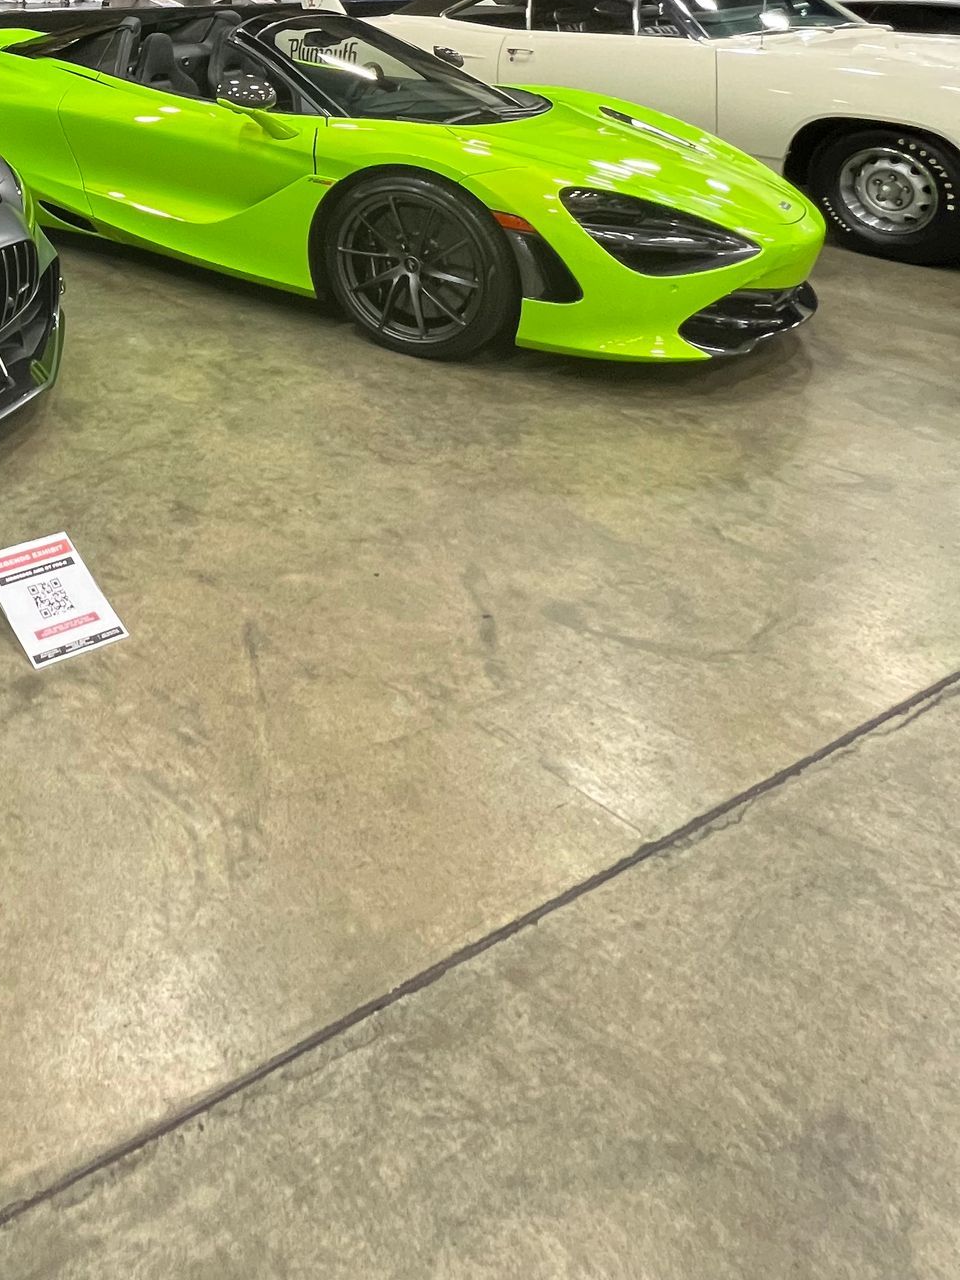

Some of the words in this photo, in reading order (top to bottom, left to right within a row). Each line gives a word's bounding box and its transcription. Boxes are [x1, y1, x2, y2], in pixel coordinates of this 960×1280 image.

[288, 38, 358, 64] Plymouth
[898, 139, 955, 211] GOODYEAR
[31, 544, 63, 559] EXHIBIT
